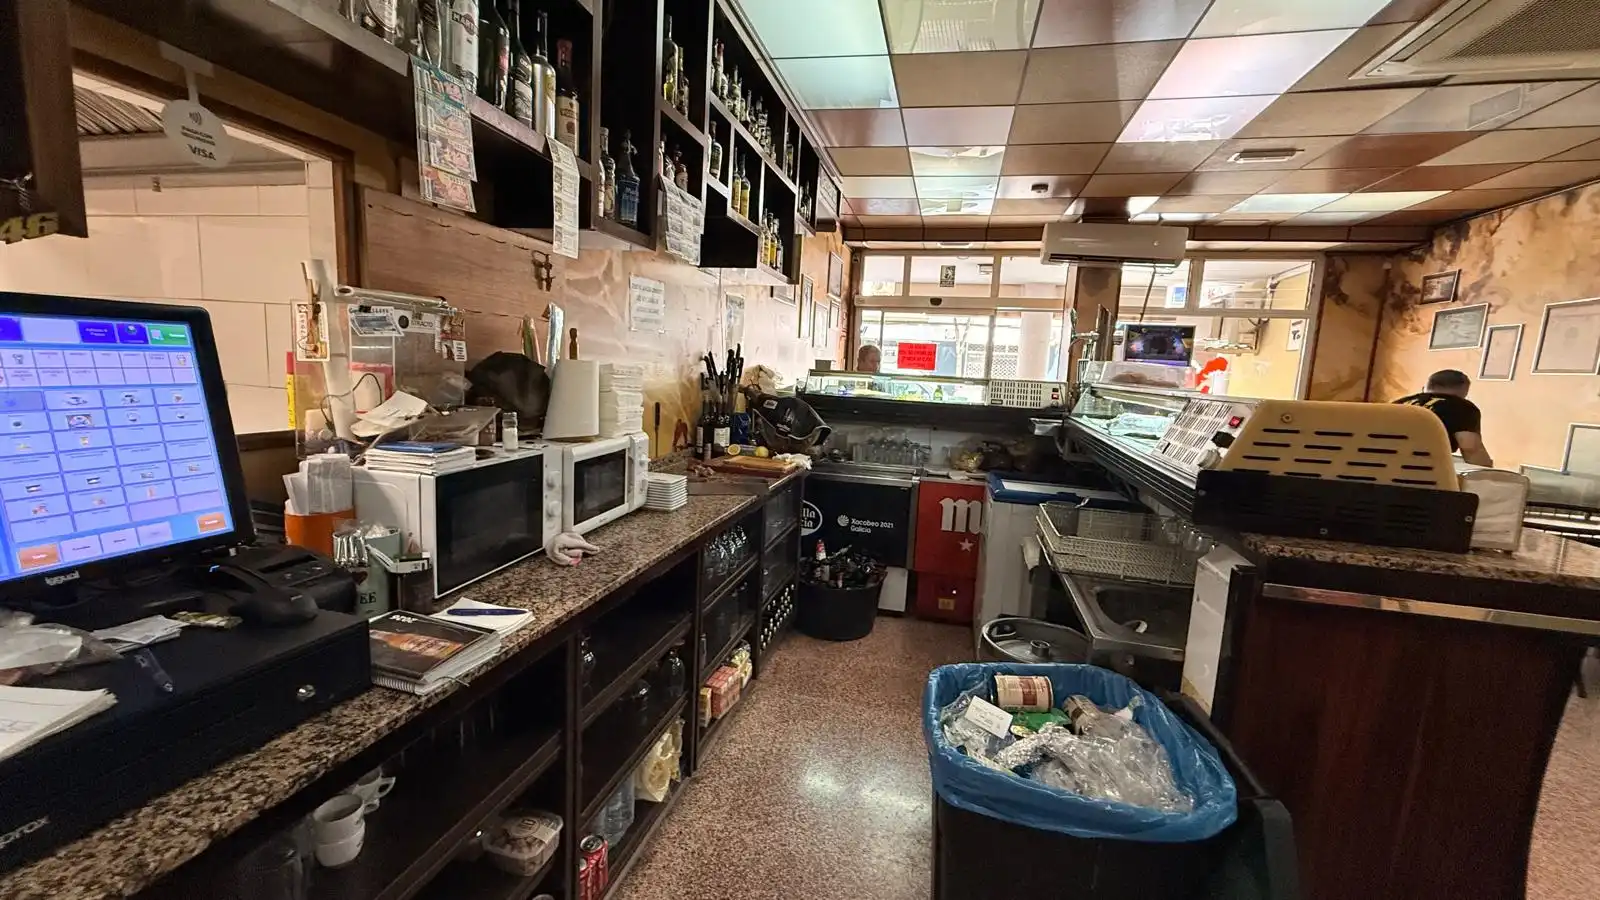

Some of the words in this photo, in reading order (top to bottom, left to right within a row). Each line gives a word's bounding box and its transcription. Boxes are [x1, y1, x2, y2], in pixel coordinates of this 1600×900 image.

[187, 143, 217, 161] VISA
[0, 212, 60, 243] 46
[850, 518, 879, 528] Xacobeo
[880, 520, 895, 529] 2021
[850, 525, 872, 534] Galicia
